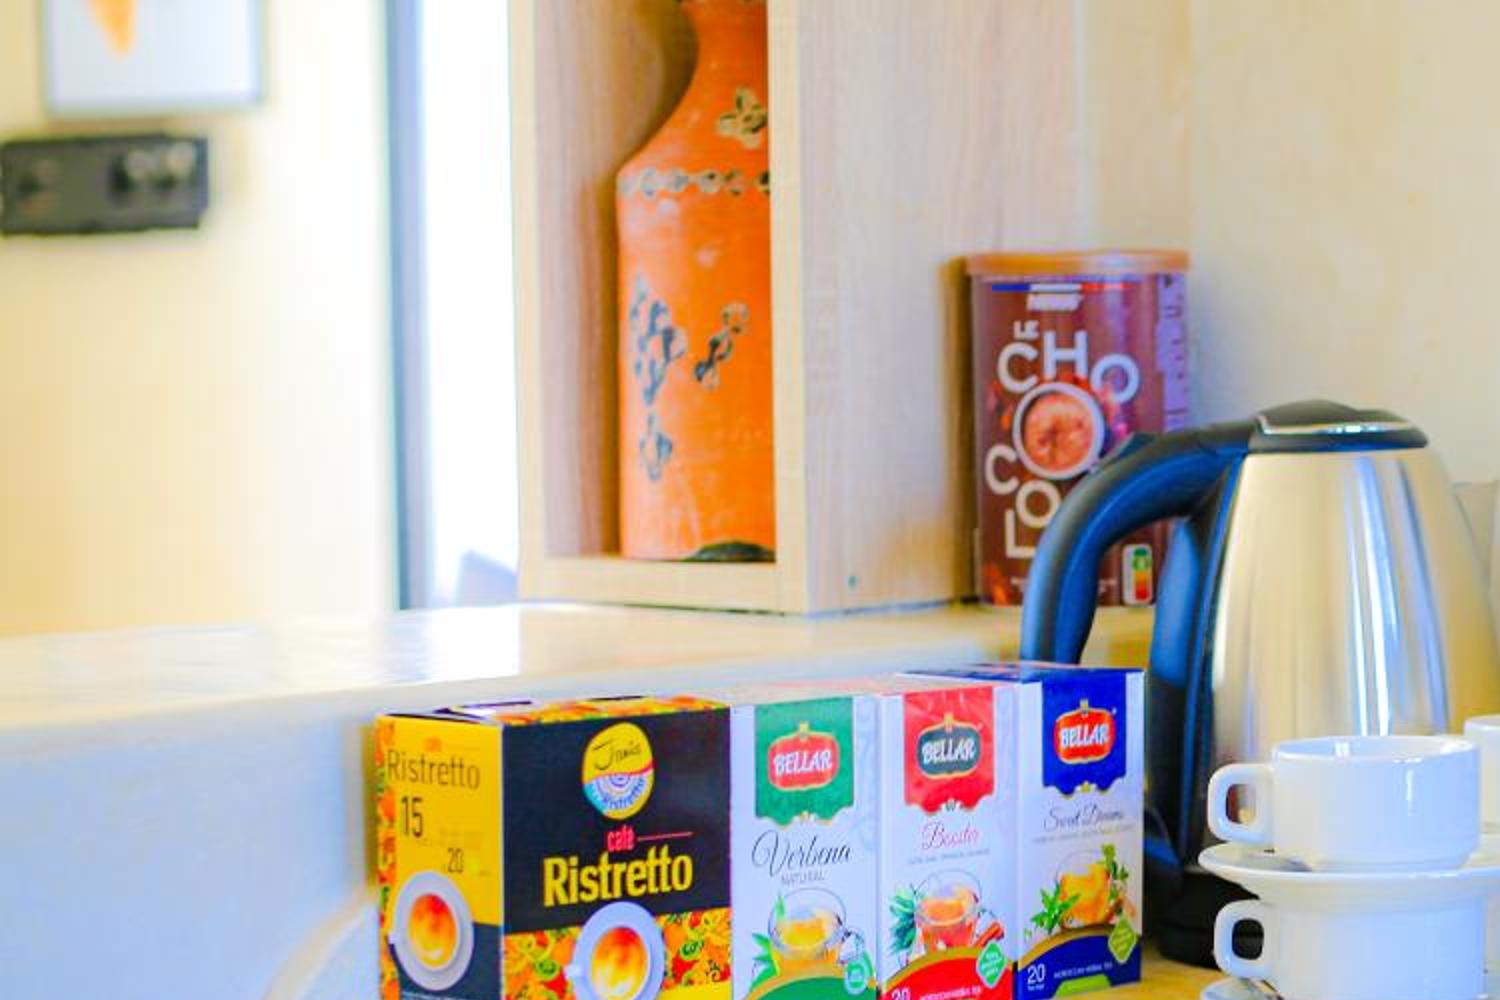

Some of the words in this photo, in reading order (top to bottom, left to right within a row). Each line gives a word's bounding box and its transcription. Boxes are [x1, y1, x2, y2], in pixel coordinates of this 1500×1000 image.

[1059, 722, 1111, 750] BELLAR
[773, 749, 833, 777] BELLAR
[921, 737, 978, 765] BELLAR
[387, 748, 480, 791] Ristretto
[401, 795, 423, 838] 15
[447, 847, 465, 874] 20
[751, 829, 853, 878] Verbena
[543, 844, 694, 907] Ristretto
[1027, 962, 1046, 984] 20
